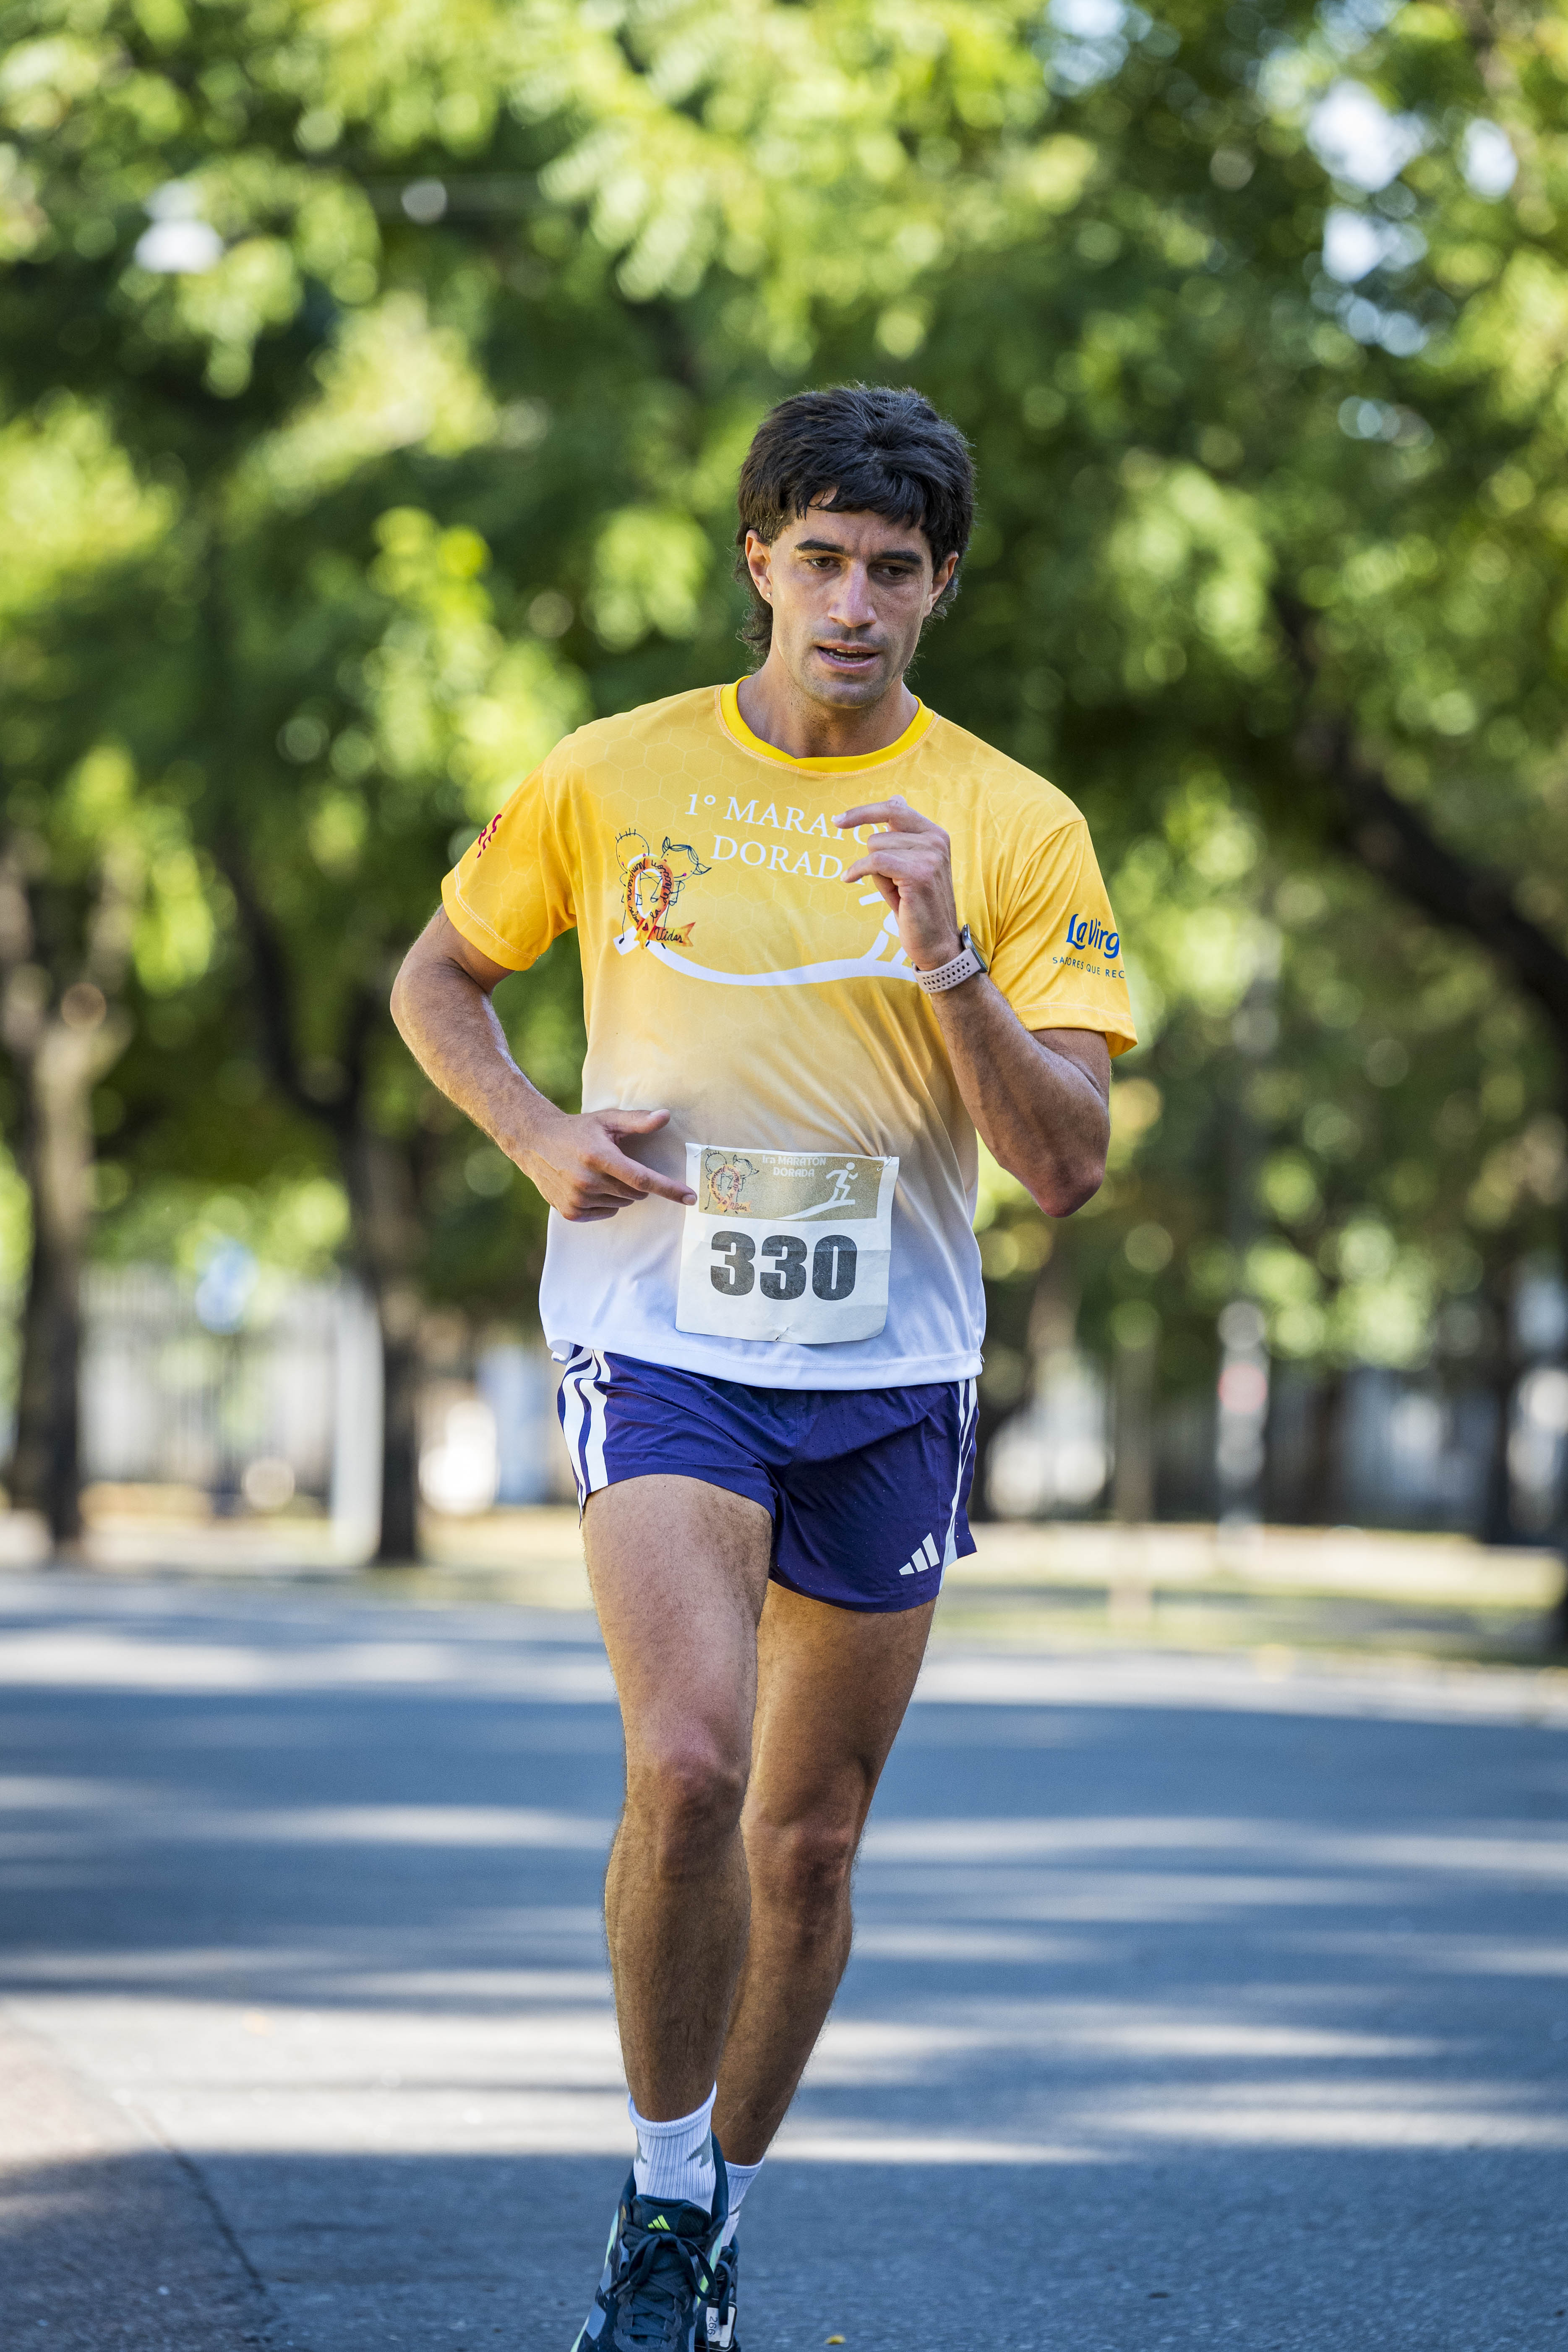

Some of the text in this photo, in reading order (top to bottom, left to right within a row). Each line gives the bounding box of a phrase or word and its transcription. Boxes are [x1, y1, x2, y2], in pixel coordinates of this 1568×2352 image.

[710, 834, 865, 886] DORAD
[1086, 963, 1101, 975] QUE
[773, 1167, 814, 1177] DORADA
[710, 1230, 858, 1301] 330
[707, 2316, 718, 2335] 266
